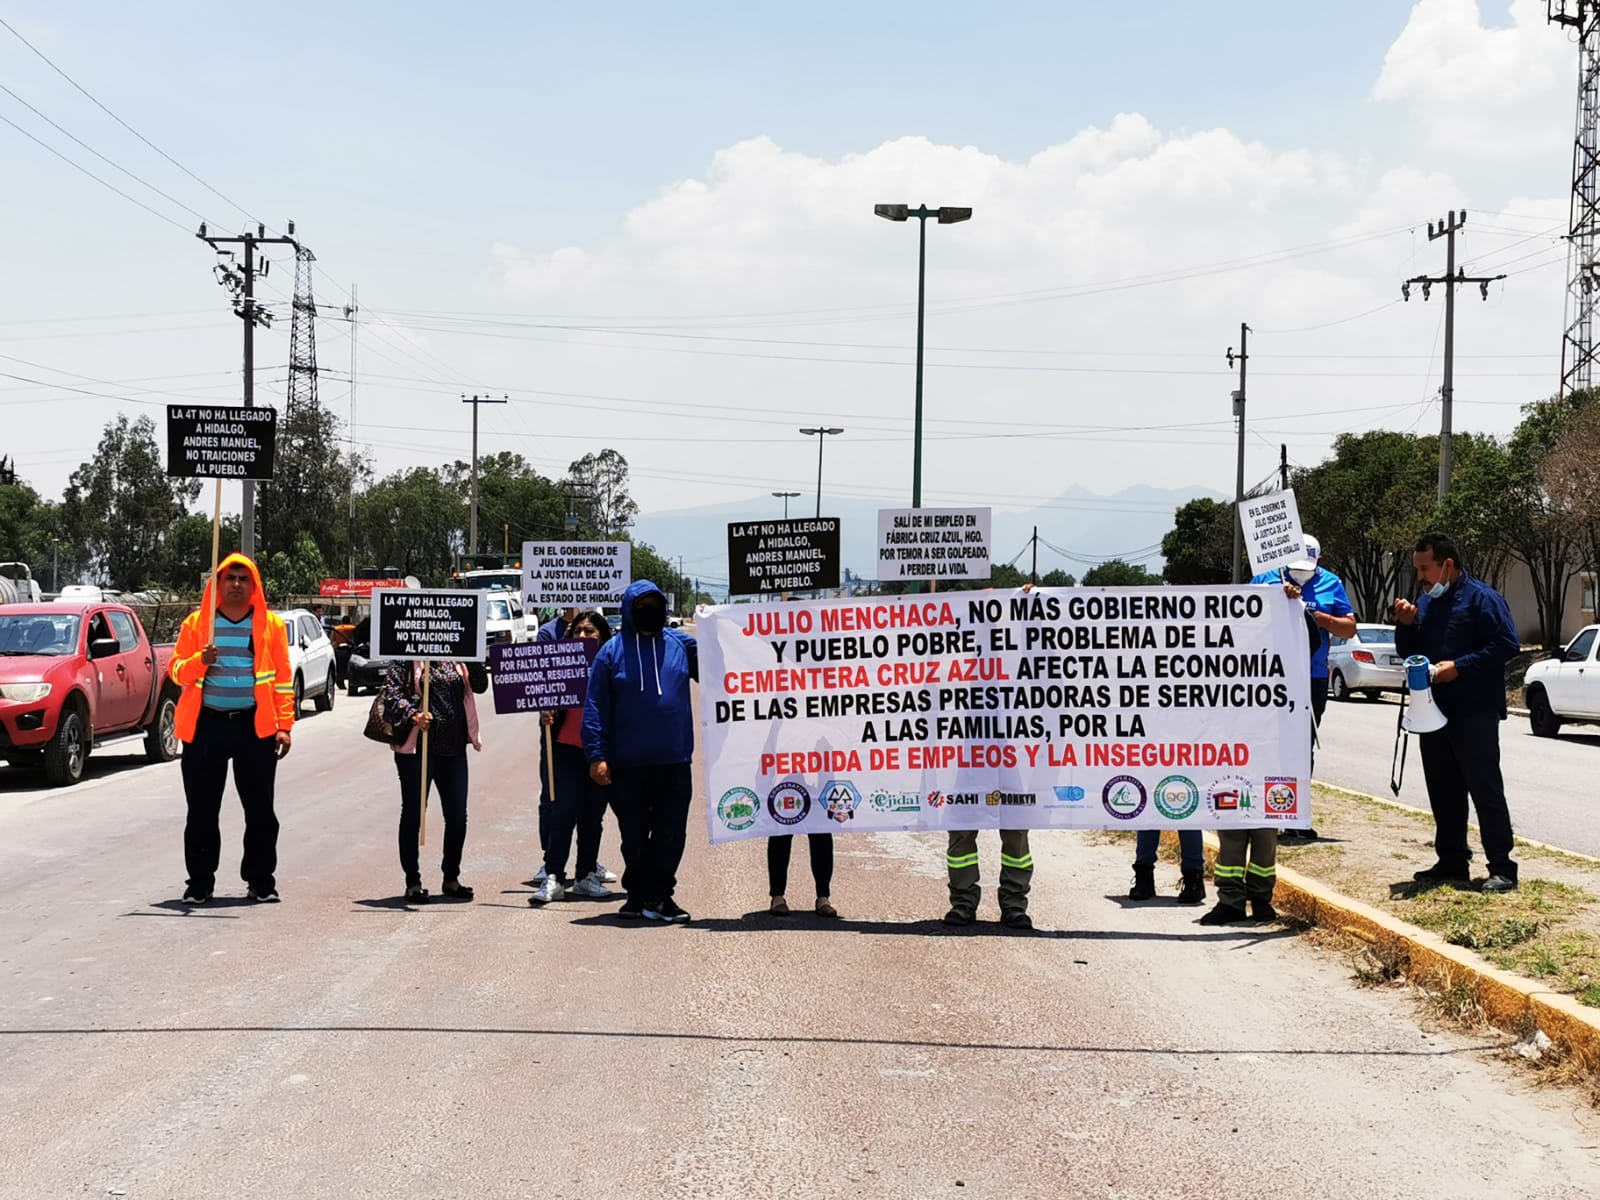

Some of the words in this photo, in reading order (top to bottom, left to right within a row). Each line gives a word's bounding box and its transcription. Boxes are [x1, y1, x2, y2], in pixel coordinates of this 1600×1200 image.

[172, 409, 183, 419] LA
[185, 410, 196, 419] 4T
[199, 410, 212, 420] NO
[215, 410, 226, 420] HA
[230, 411, 271, 421] LLEGADO
[196, 423, 202, 433] A
[205, 424, 246, 436] HIDALGO,
[184, 437, 218, 447] ANDRES
[221, 438, 261, 451] MANUEL,
[186, 450, 199, 460] NO
[201, 451, 255, 462] TRAICIONES
[196, 464, 206, 474] AL
[210, 464, 247, 475] PUEBLO.
[894, 513, 910, 528] SALÍ
[912, 516, 922, 527] DE
[924, 516, 932, 527] MI
[934, 515, 964, 527] EMPLEO
[966, 515, 976, 526] EN
[733, 526, 745, 537] LA
[747, 526, 758, 536] 4T
[761, 525, 774, 535] NO
[778, 523, 790, 534] HA
[793, 521, 835, 533] LLEGADO
[759, 539, 765, 549] A
[768, 536, 810, 548] HIDALGO,
[886, 529, 918, 544] FÁBRICA
[920, 532, 940, 543] CRUZ
[942, 531, 963, 545] AZUL,
[965, 531, 983, 542] HGO.
[533, 547, 544, 555] EN
[548, 547, 557, 555] EL
[560, 546, 604, 555] GOBIERNO
[607, 547, 617, 555] DE
[746, 552, 783, 563] ANDRES
[786, 549, 826, 561] MANUEL,
[880, 548, 895, 560] POR
[897, 548, 922, 560] TEMOR
[924, 548, 929, 559] A
[931, 548, 945, 559] SER
[947, 547, 989, 560] GOLPEADO,
[539, 559, 564, 567] JULIO
[567, 559, 614, 567] MENCHACA
[750, 567, 762, 576] NO
[765, 562, 820, 576] TRAICIONES
[900, 564, 905, 575] A
[907, 564, 936, 575] PERDER
[938, 563, 947, 574] LA
[949, 563, 968, 574] VIDA.
[531, 570, 541, 579] LA
[544, 570, 583, 579] JUSTICIA
[586, 570, 596, 579] DE
[600, 570, 610, 579] LA
[612, 570, 623, 579] 4T
[542, 582, 554, 591] NO
[556, 582, 568, 591] HA
[571, 582, 609, 591] LLEGADO
[760, 579, 772, 590] AL
[775, 576, 813, 589] PUEBLO.
[384, 596, 395, 605] LA
[396, 597, 406, 606] 4T
[409, 597, 420, 606] NO
[423, 598, 434, 606] HA
[437, 598, 473, 607] LLEGADO
[528, 594, 538, 603] AL
[541, 594, 573, 603] ESTADO
[576, 594, 587, 603] DE
[406, 609, 411, 617] A
[414, 609, 451, 619] HIDALGO,
[742, 610, 812, 636] JULIO
[821, 602, 961, 632] MENCHACA,
[969, 599, 1002, 623] NO
[1010, 592, 1061, 621] MÁS
[1069, 596, 1196, 620] GOBIERNO
[1205, 594, 1263, 618] RICO
[394, 621, 426, 629] ANDRES
[429, 621, 464, 632] MANUEL,
[397, 632, 408, 640] NO
[411, 633, 459, 642] TRAICIONES
[771, 641, 787, 663] Y
[796, 634, 889, 662] PUEBLO
[898, 630, 982, 656] POBRE,
[991, 628, 1018, 650] EL
[1026, 626, 1157, 650] PROBLEMA
[1165, 625, 1196, 648] DE
[1204, 624, 1234, 648] LA
[405, 644, 416, 652] AL
[418, 644, 452, 653] PUEBLO.
[502, 648, 512, 658] NO
[514, 646, 542, 657] QUIERO
[544, 642, 584, 654] DELINQUIR
[500, 661, 515, 671] POR
[517, 659, 538, 669] FALTA
[540, 658, 550, 667] DE
[551, 655, 588, 666] TRABAJO,
[494, 672, 546, 684] GOBERNADOR,
[547, 669, 585, 680] RESUELVE
[587, 668, 592, 677] E
[724, 666, 870, 694] CEMENTERA
[877, 661, 941, 686] CRUZ
[948, 657, 1009, 682] AZUL
[1017, 656, 1109, 680] AFECTA
[1117, 655, 1146, 678] LA
[1155, 649, 1285, 678] ECONOMÍA
[525, 683, 566, 695] CONFLICTO
[516, 699, 526, 708] DE
[528, 698, 537, 708] LA
[539, 696, 559, 707] CRUZ
[560, 695, 580, 705] AZUL
[715, 700, 746, 723] DE
[754, 698, 798, 720] LAS
[806, 690, 931, 718] EMPRESAS
[940, 685, 1110, 711] PRESTADORAS
[1120, 685, 1150, 708] DE
[1157, 684, 1295, 713] SERVICIOS,
[862, 721, 877, 743] A
[886, 718, 928, 741] LAS
[937, 714, 1051, 742] FAMILIAS,
[1059, 714, 1108, 737] POR
[1116, 714, 1146, 737] LA
[761, 750, 862, 775] PERDIDA
[870, 748, 900, 771] DE
[908, 745, 1017, 769] EMPLEOS
[1024, 744, 1040, 767] Y
[1048, 744, 1076, 767] LA
[1086, 743, 1249, 767] INSEGURIDAD
[946, 794, 978, 804] SAHI
[1166, 792, 1186, 802] QG
